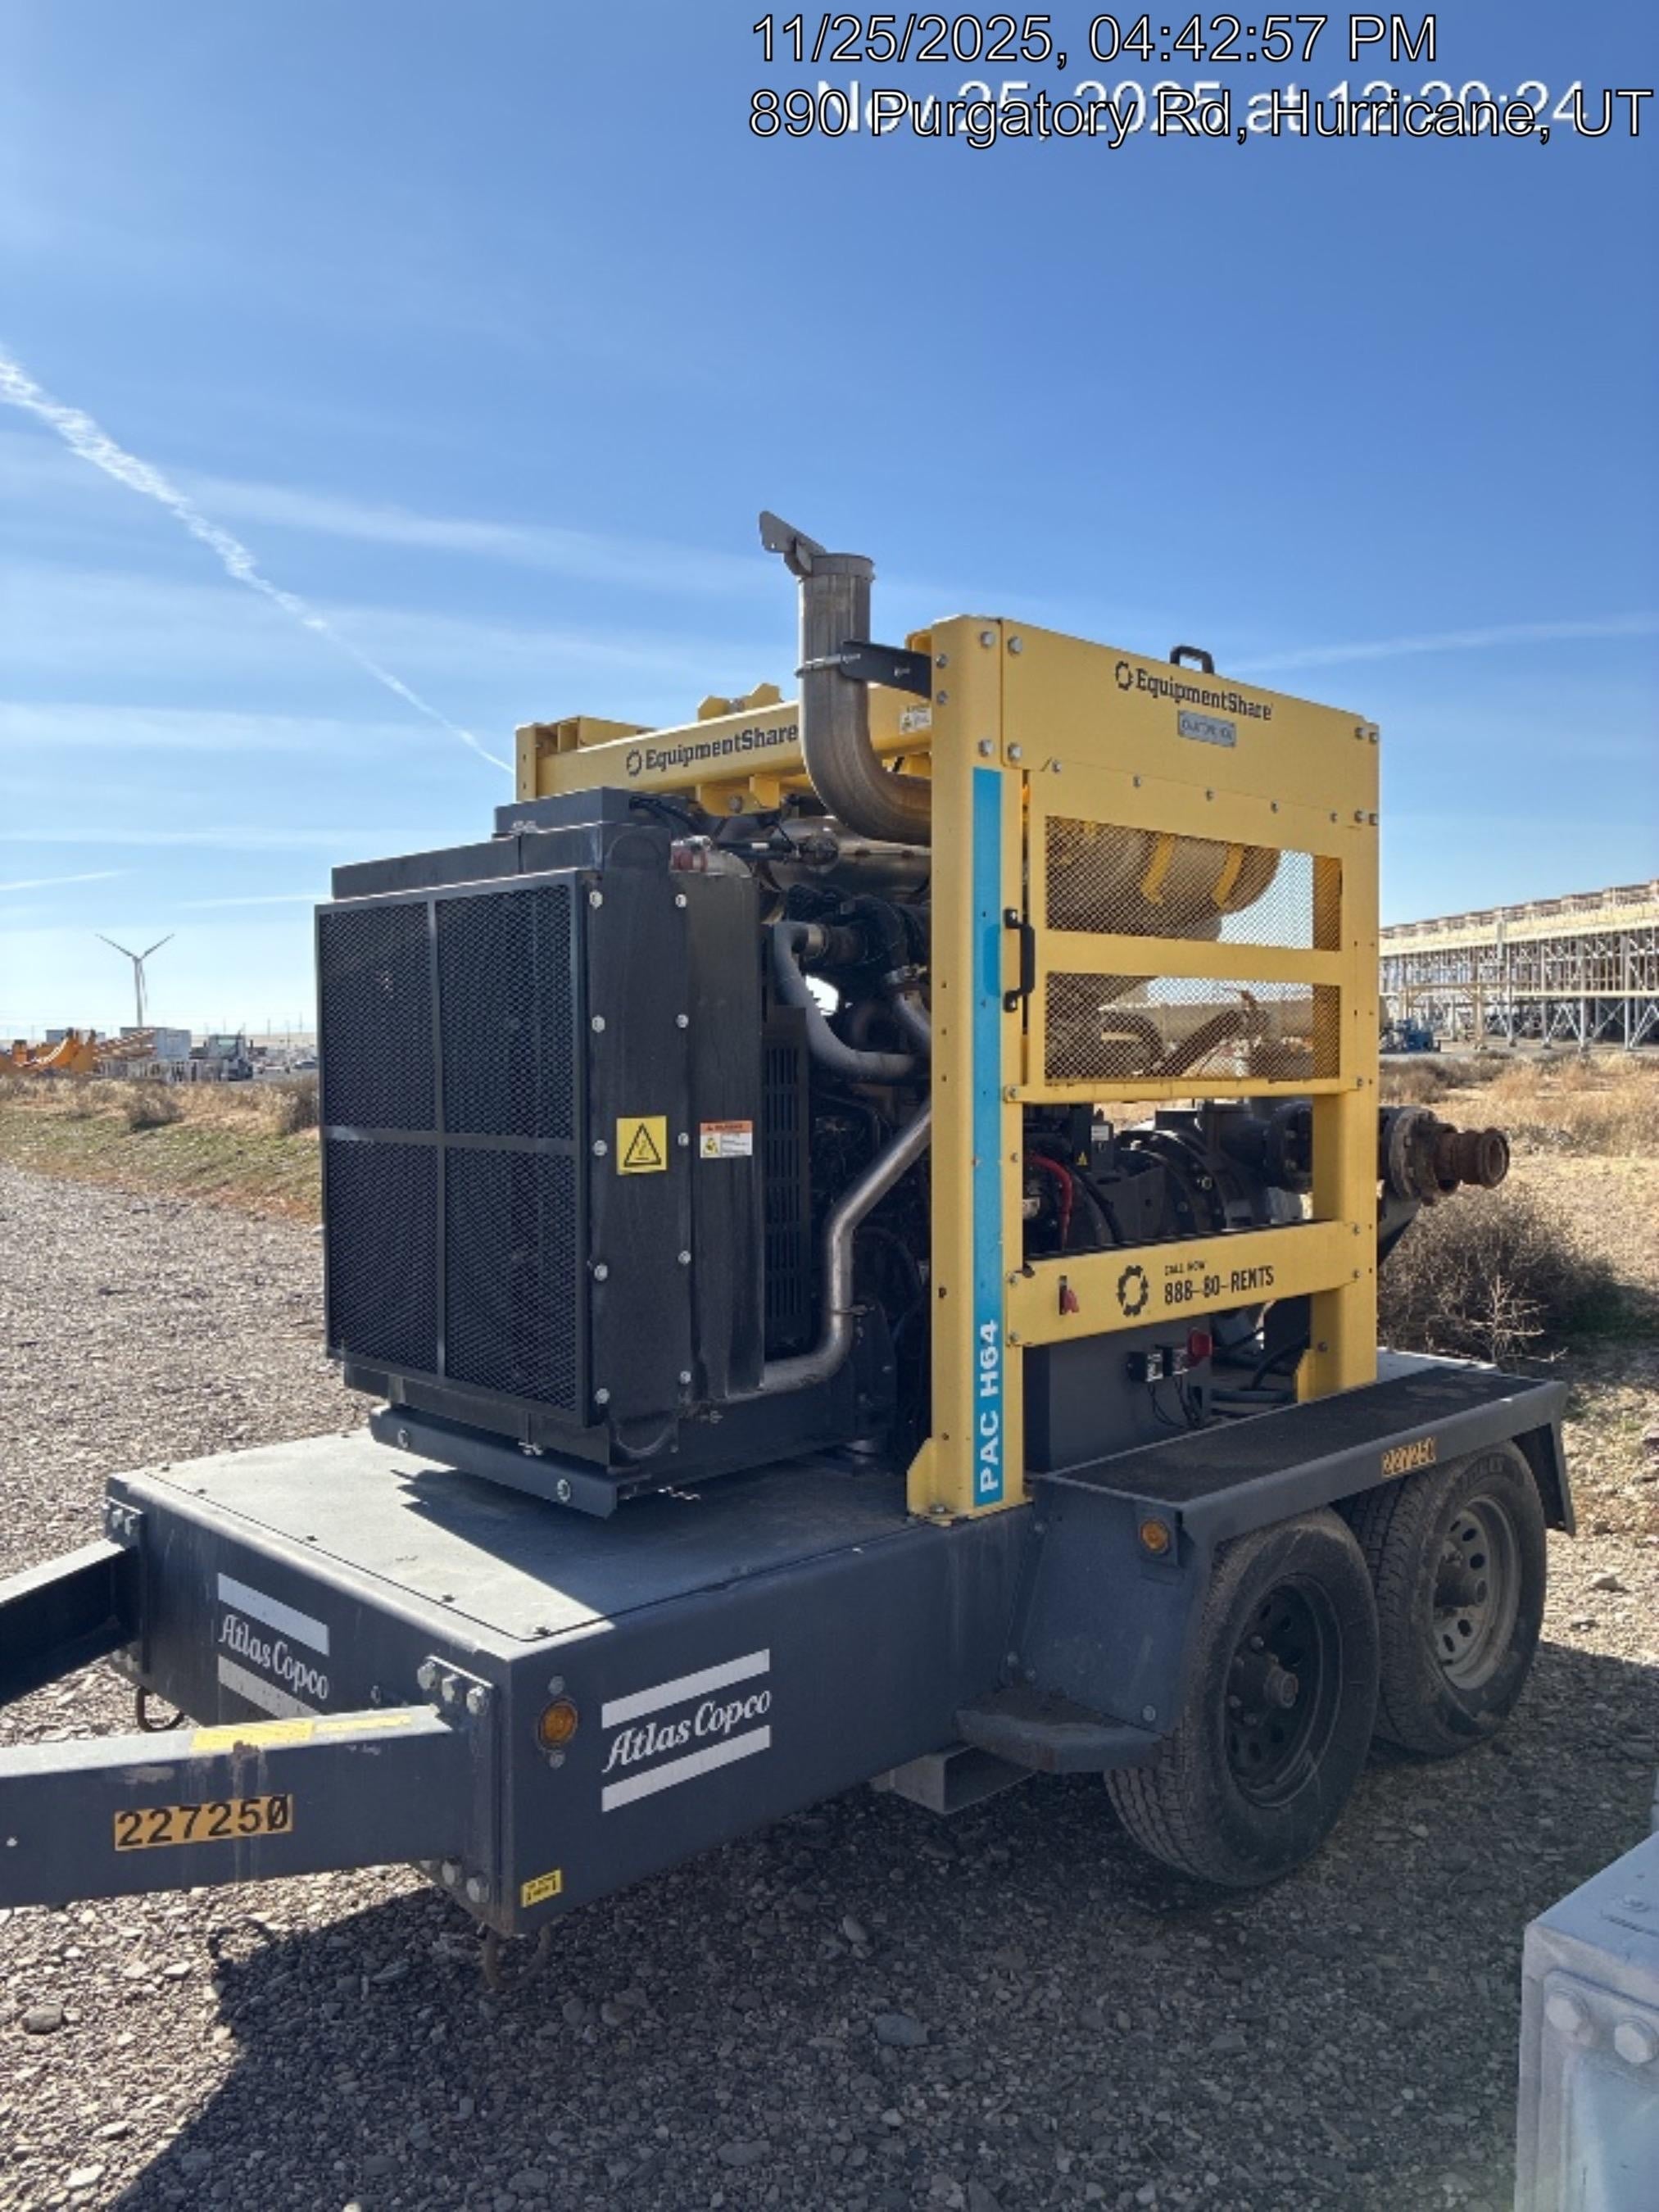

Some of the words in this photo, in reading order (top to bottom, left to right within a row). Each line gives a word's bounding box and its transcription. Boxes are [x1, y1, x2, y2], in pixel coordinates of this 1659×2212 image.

[1135, 668, 1272, 721] EquipmentShare
[646, 724, 799, 771] EquipmentShare
[980, 1319, 999, 1398] H64
[980, 1410, 999, 1493] PAC
[218, 1614, 272, 1669] Atlas
[272, 1641, 329, 1700] Copco
[601, 1720, 690, 1774] Atlas
[694, 1690, 772, 1735] Copco
[116, 1794, 288, 1847] 227250
